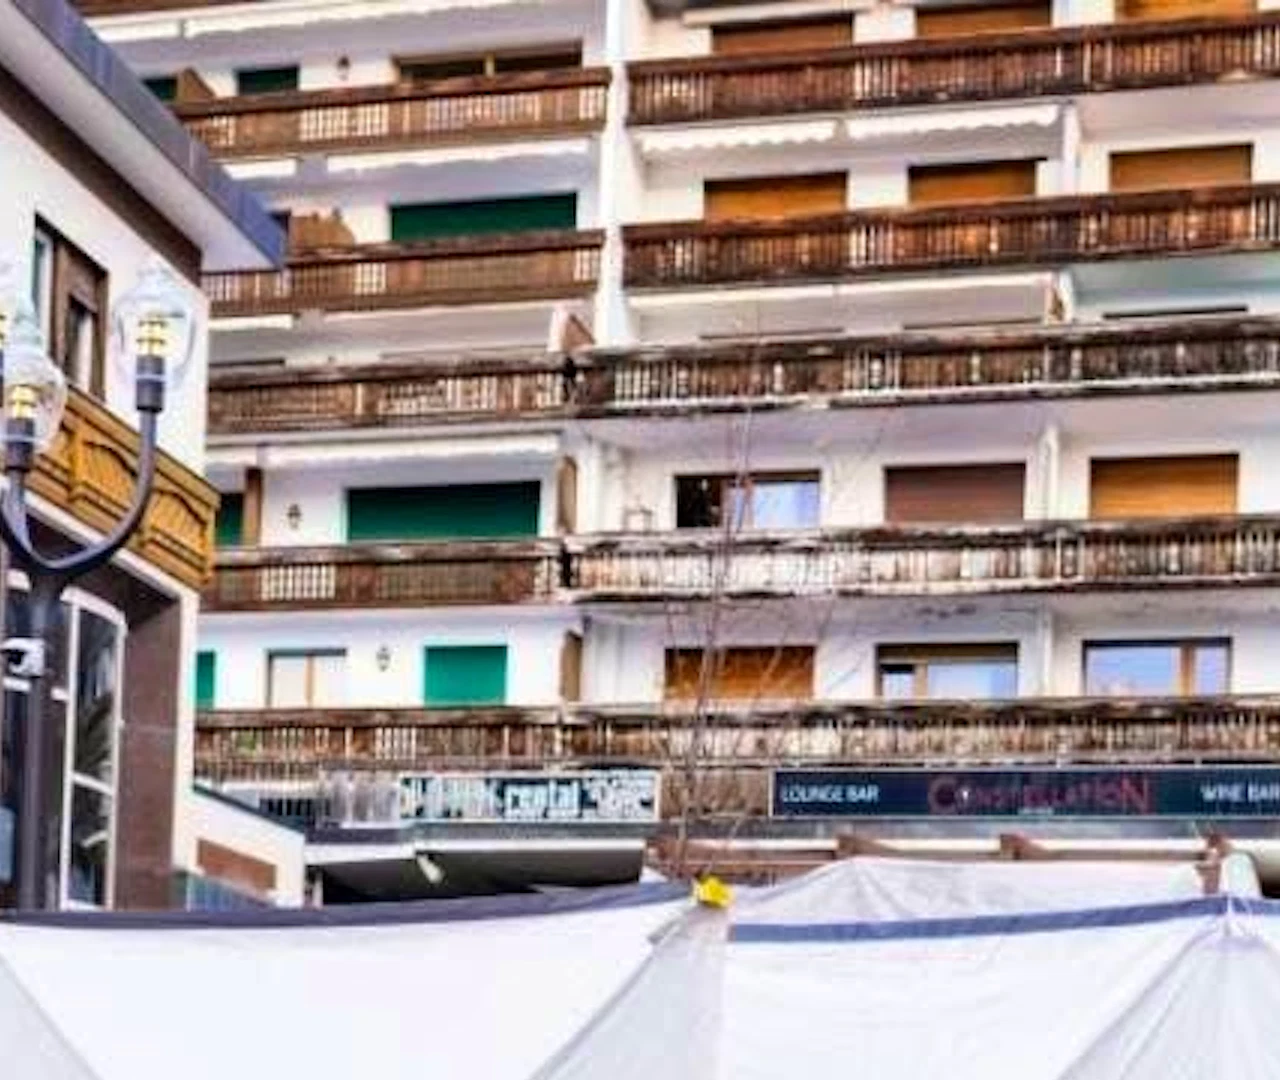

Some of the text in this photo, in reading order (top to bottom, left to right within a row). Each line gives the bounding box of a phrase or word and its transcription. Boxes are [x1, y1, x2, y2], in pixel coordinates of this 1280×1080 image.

[782, 784, 880, 803] LOUNGE BAR
[1200, 783, 1280, 802] WINE BAR
